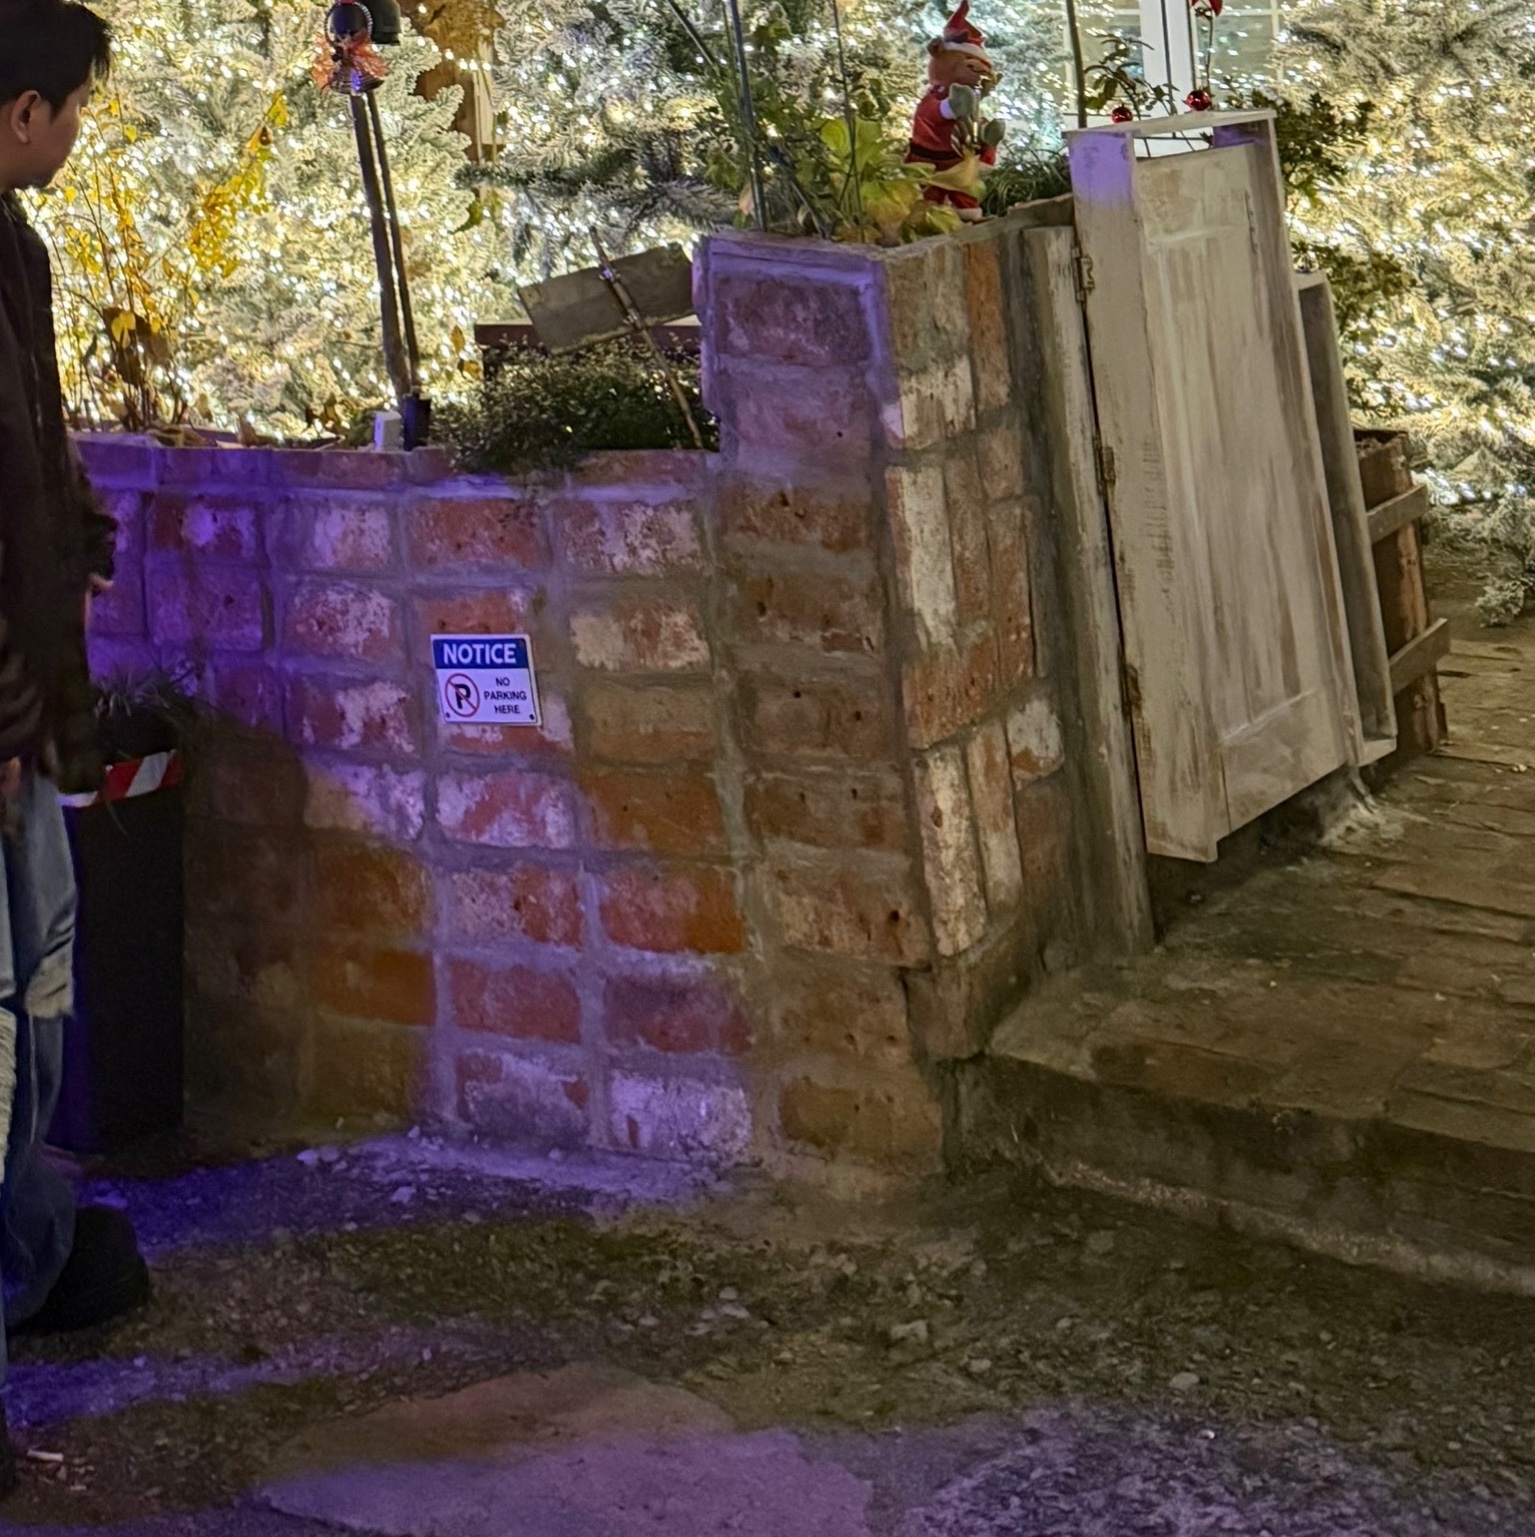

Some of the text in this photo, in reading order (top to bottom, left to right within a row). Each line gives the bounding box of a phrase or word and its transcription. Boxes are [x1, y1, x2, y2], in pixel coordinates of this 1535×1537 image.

[442, 643, 517, 664] NOTICE
[495, 677, 510, 687] NO
[484, 690, 527, 701] PARKING
[494, 705, 521, 714] HERE
